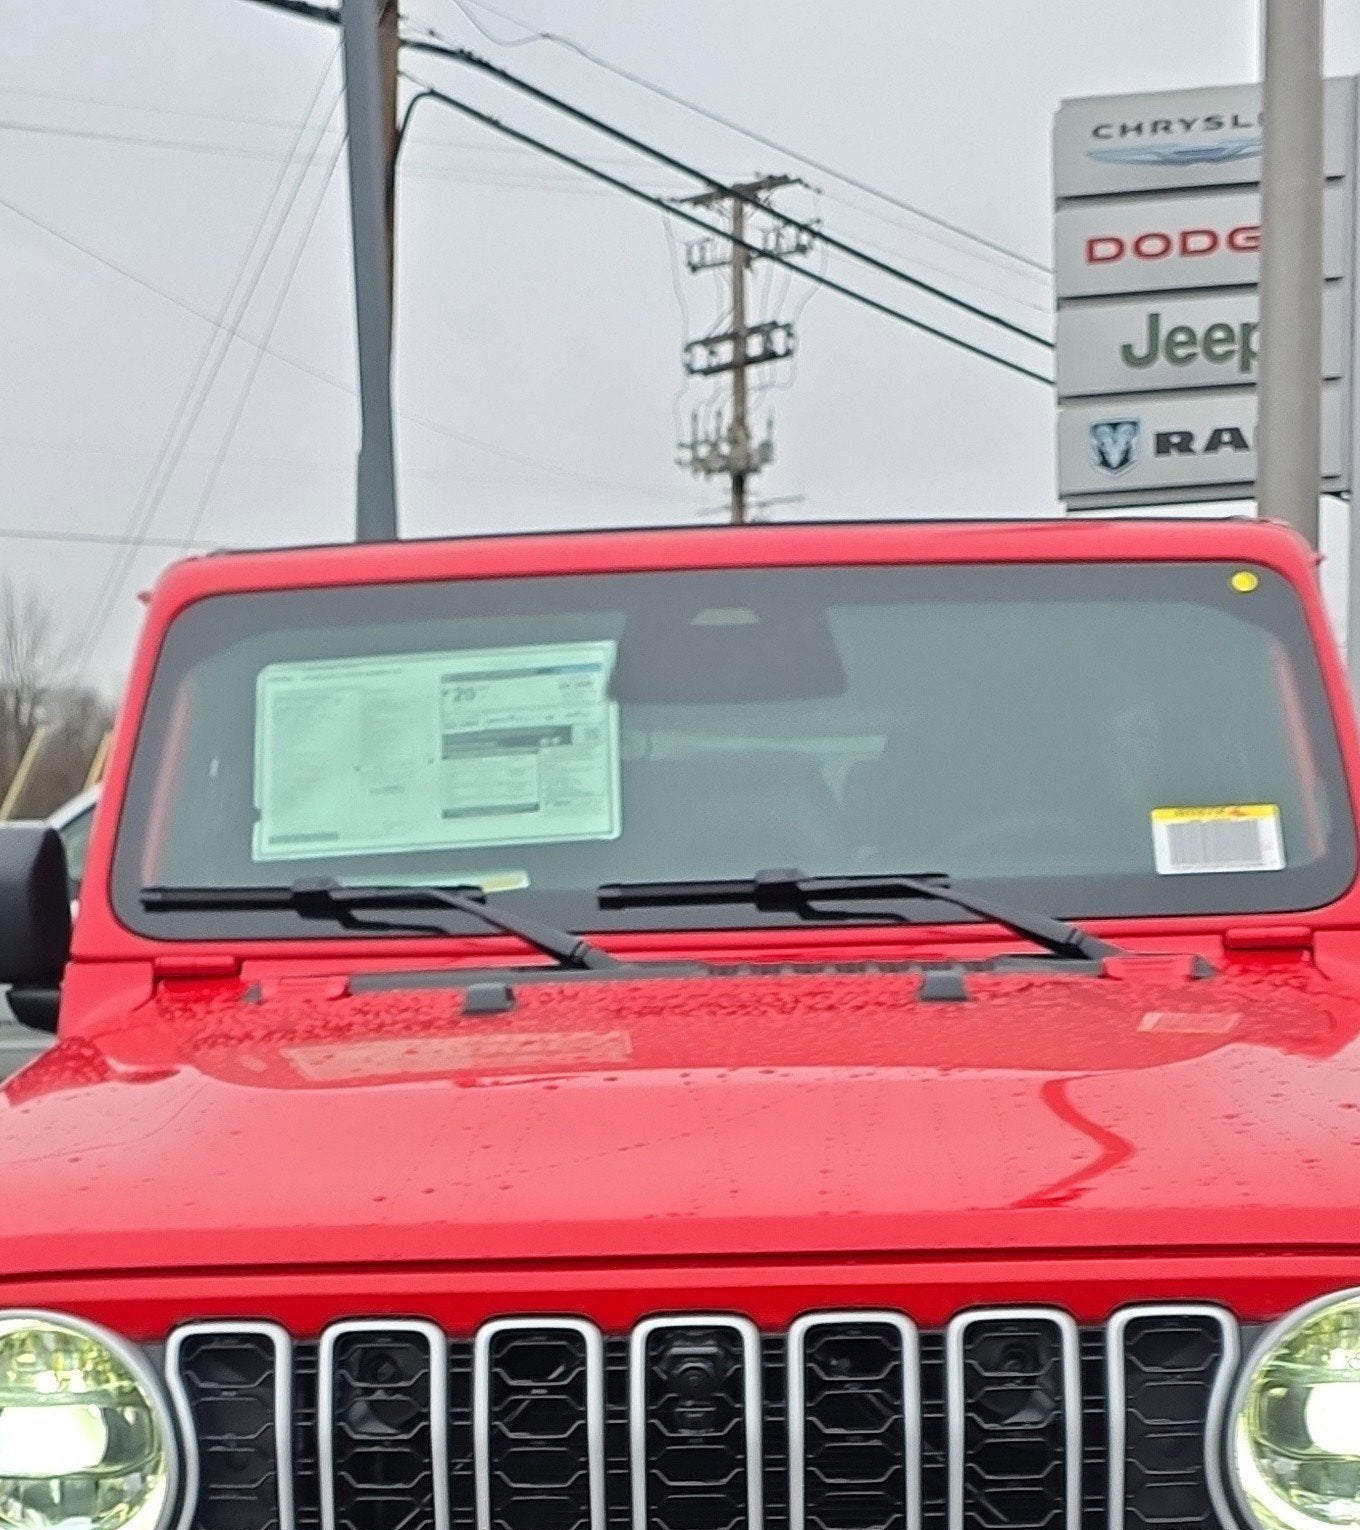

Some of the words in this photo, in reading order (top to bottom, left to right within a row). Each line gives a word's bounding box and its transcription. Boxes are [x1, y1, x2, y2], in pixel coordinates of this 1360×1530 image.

[1092, 112, 1262, 140] CHRYSL
[1086, 224, 1261, 265] DODG
[1154, 427, 1250, 455] RA
